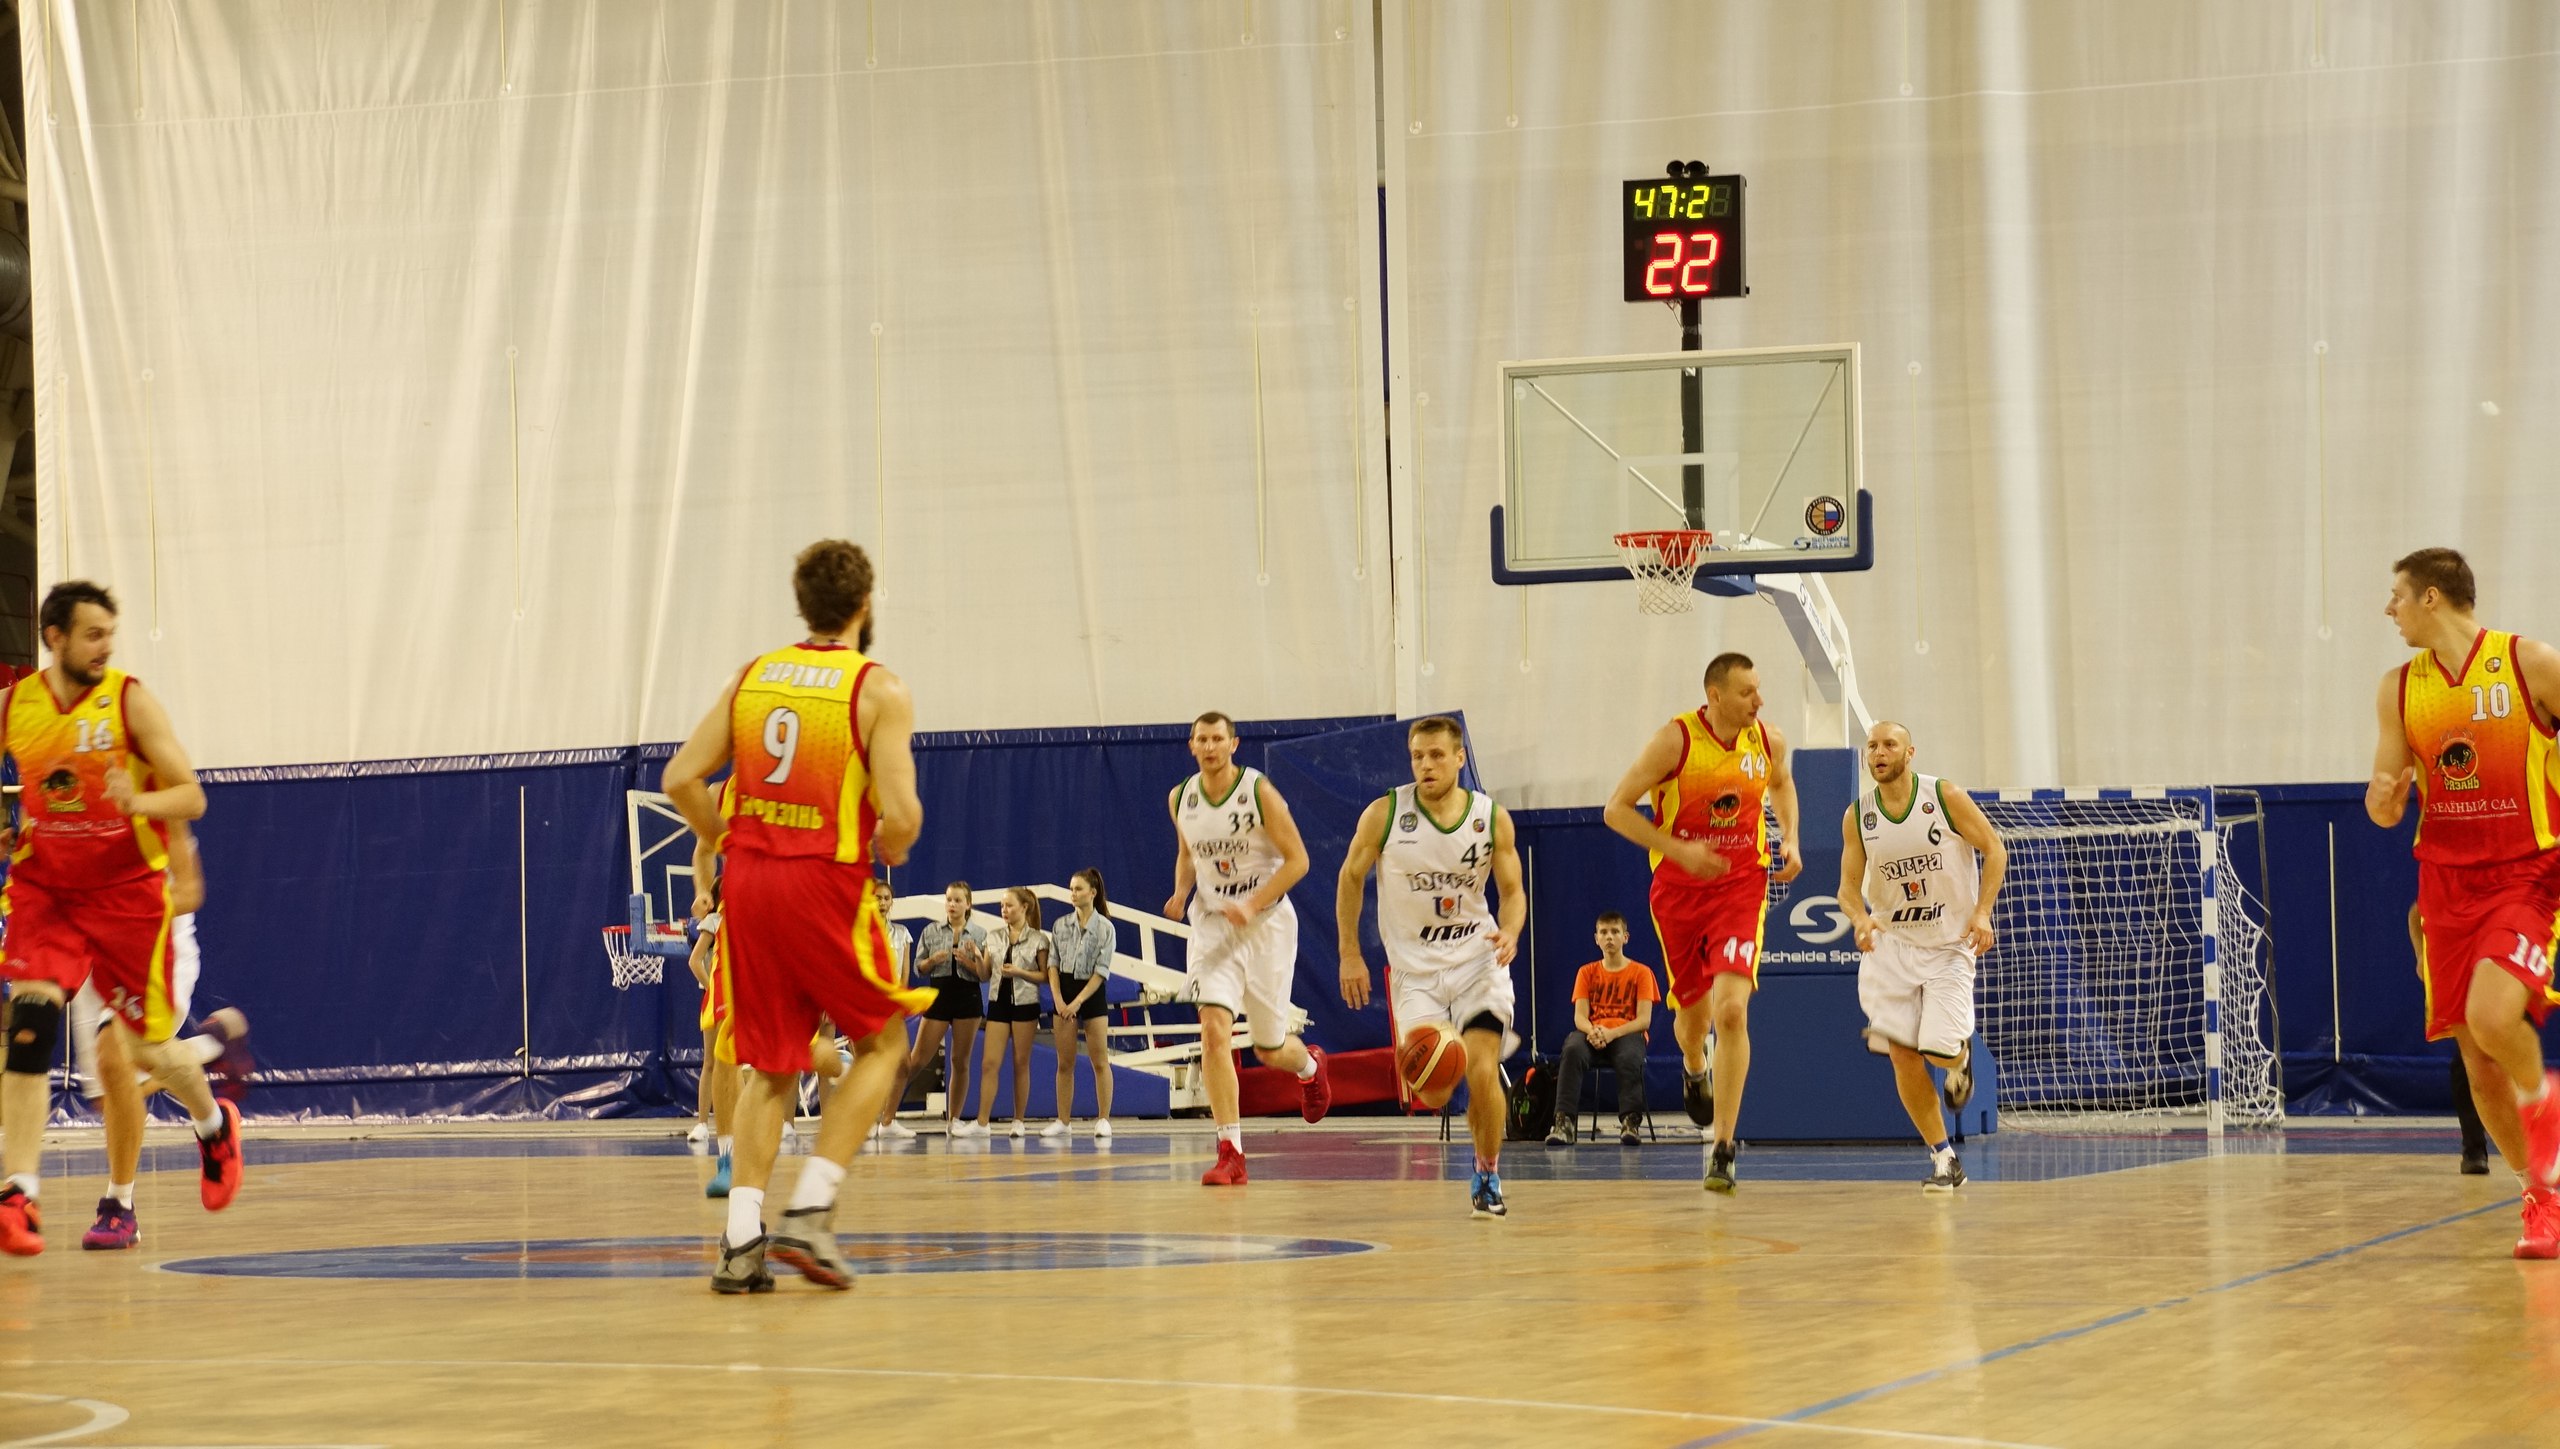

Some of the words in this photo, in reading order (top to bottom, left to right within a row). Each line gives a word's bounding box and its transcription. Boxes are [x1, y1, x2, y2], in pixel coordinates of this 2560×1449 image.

[1635, 185, 1710, 219] 47:2
[1645, 233, 1718, 295] 22
[2471, 682, 2512, 721] 10
[74, 718, 114, 753] 16
[762, 706, 800, 785] 9
[1739, 751, 1767, 780] 44
[2430, 799, 2488, 814] ЗЕЛЁНЫЙ
[2490, 797, 2518, 811] САД
[1228, 811, 1255, 836] 33
[1927, 820, 1942, 846] 6
[1891, 902, 1946, 923] UTair
[1419, 921, 1481, 942] UTair
[1723, 936, 1755, 969] 44
[1760, 951, 1827, 963] Schelde
[1830, 950, 1862, 965] Spo
[2508, 932, 2548, 978] 10
